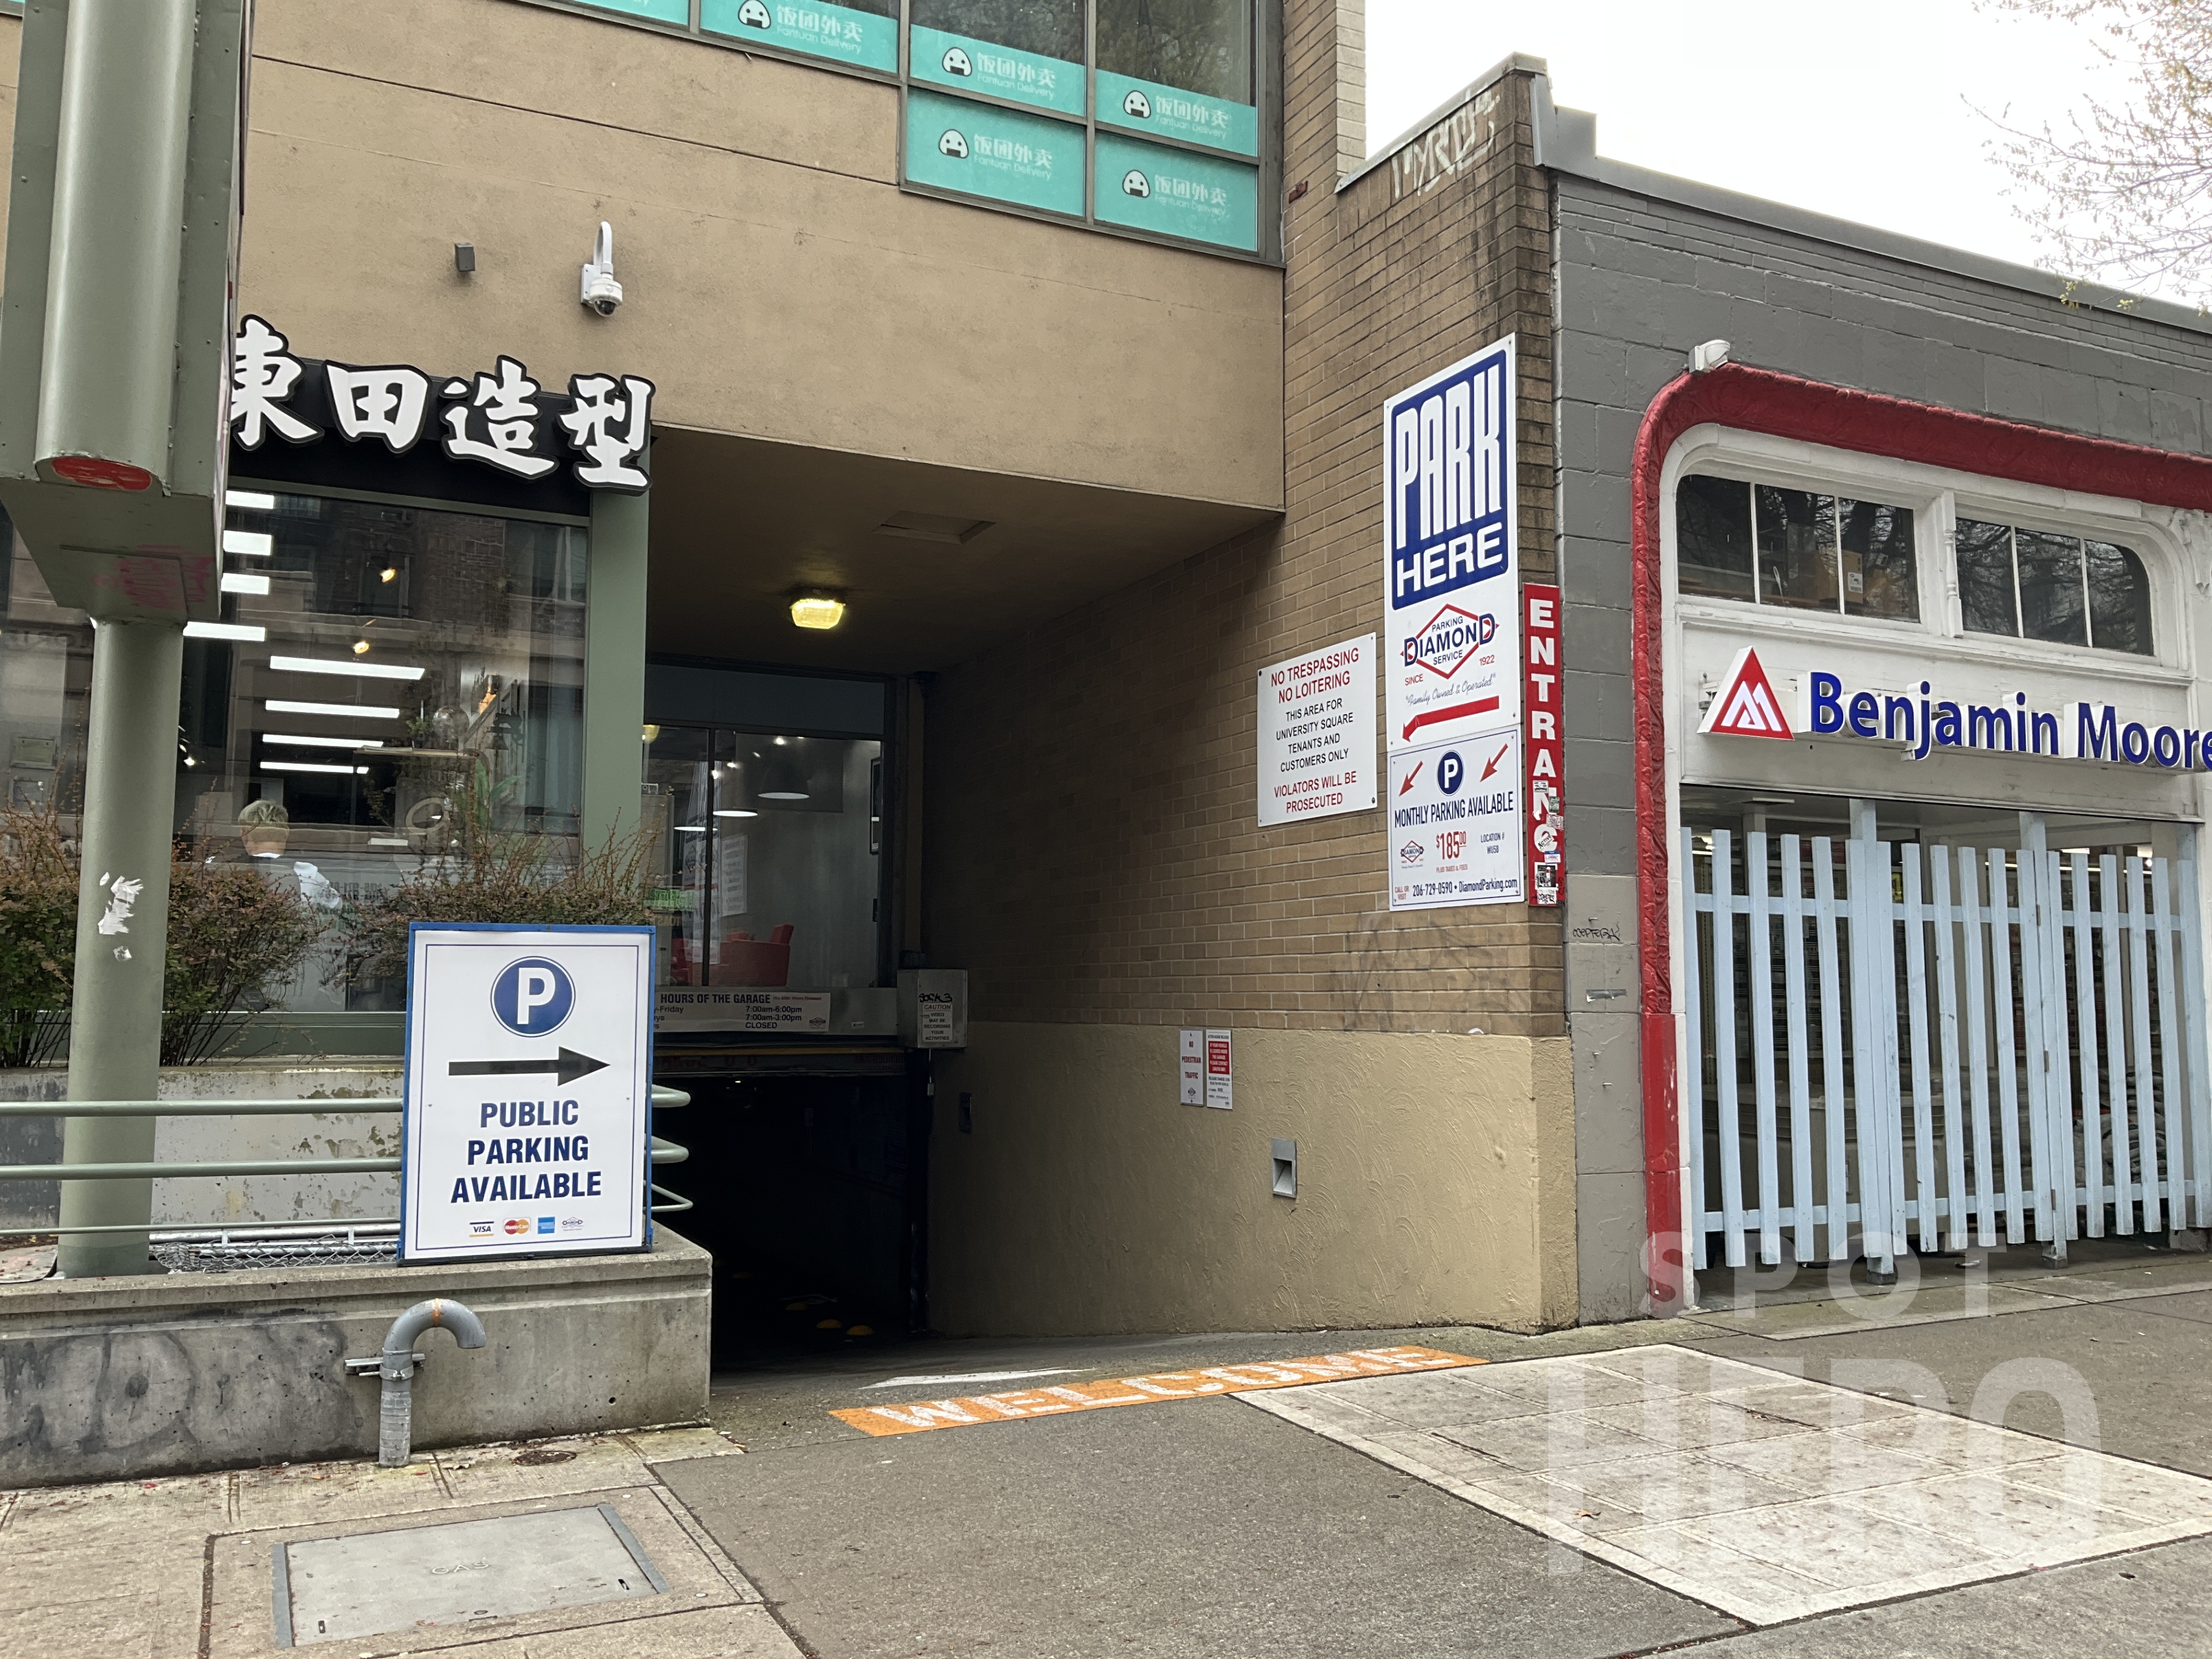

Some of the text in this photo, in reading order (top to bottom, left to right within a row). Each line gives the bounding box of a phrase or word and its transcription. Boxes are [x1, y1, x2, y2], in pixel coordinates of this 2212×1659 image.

[778, 4, 863, 42] 饭团外卖
[778, 28, 862, 55] Fantuan Delivery
[977, 52, 1056, 89] 饭团外卖
[977, 74, 1054, 101] Fantuan Delivery
[1156, 96, 1228, 128] 饭团外卖
[1156, 115, 1226, 140] Fantuan Delivery
[974, 134, 1053, 169] 饭团外卖
[974, 156, 1051, 181] Fantuan Delivery
[1154, 175, 1226, 206] 饭团外卖
[232, 316, 654, 491] 東田造型
[1396, 363, 1502, 550] PARK
[1397, 522, 1502, 597] HERE
[1432, 616, 1463, 632] PARKING
[1404, 613, 1495, 667] DIAMOND
[1271, 647, 1359, 687] NO TRESPASSING
[1404, 654, 1495, 686] SINCE 1922
[1433, 650, 1463, 665] SERVICE
[1278, 671, 1351, 704] NO LOITERING
[1432, 685, 1453, 699] Owned
[1286, 698, 1342, 722] THIS AREA FOR
[1809, 671, 2059, 756] Benjamin
[1276, 713, 1354, 741] UNIVERSITY SQUARE
[1288, 733, 1340, 755] TENANTS AND
[1280, 748, 1349, 772] CUSTOMERS ONLY
[1444, 759, 1459, 789] P
[1274, 771, 1357, 798] VIOLATORS WILL BE
[1286, 793, 1343, 813] PROSECUTED
[1395, 791, 1514, 828] MONTHLY PARKING AVAILABLE
[1480, 832, 1501, 843] LOCATION
[1412, 878, 1517, 897] 206-729-0590 DiamondParking.com
[517, 967, 556, 1025] P
[660, 994, 694, 1003] HOURS
[696, 994, 710, 1003] OF
[712, 994, 730, 1003] THE
[733, 994, 771, 1003] GARAGE
[745, 1006, 802, 1014] 7:00am-6:00pm
[745, 1014, 802, 1022] 7:00am-3:00pm
[480, 1100, 578, 1128] PUBLIC
[468, 1135, 588, 1165] PARKING
[450, 1171, 601, 1203] AVAILABLE
[868, 1346, 1455, 1428] WELCOME
[431, 1560, 489, 1574] GAS
